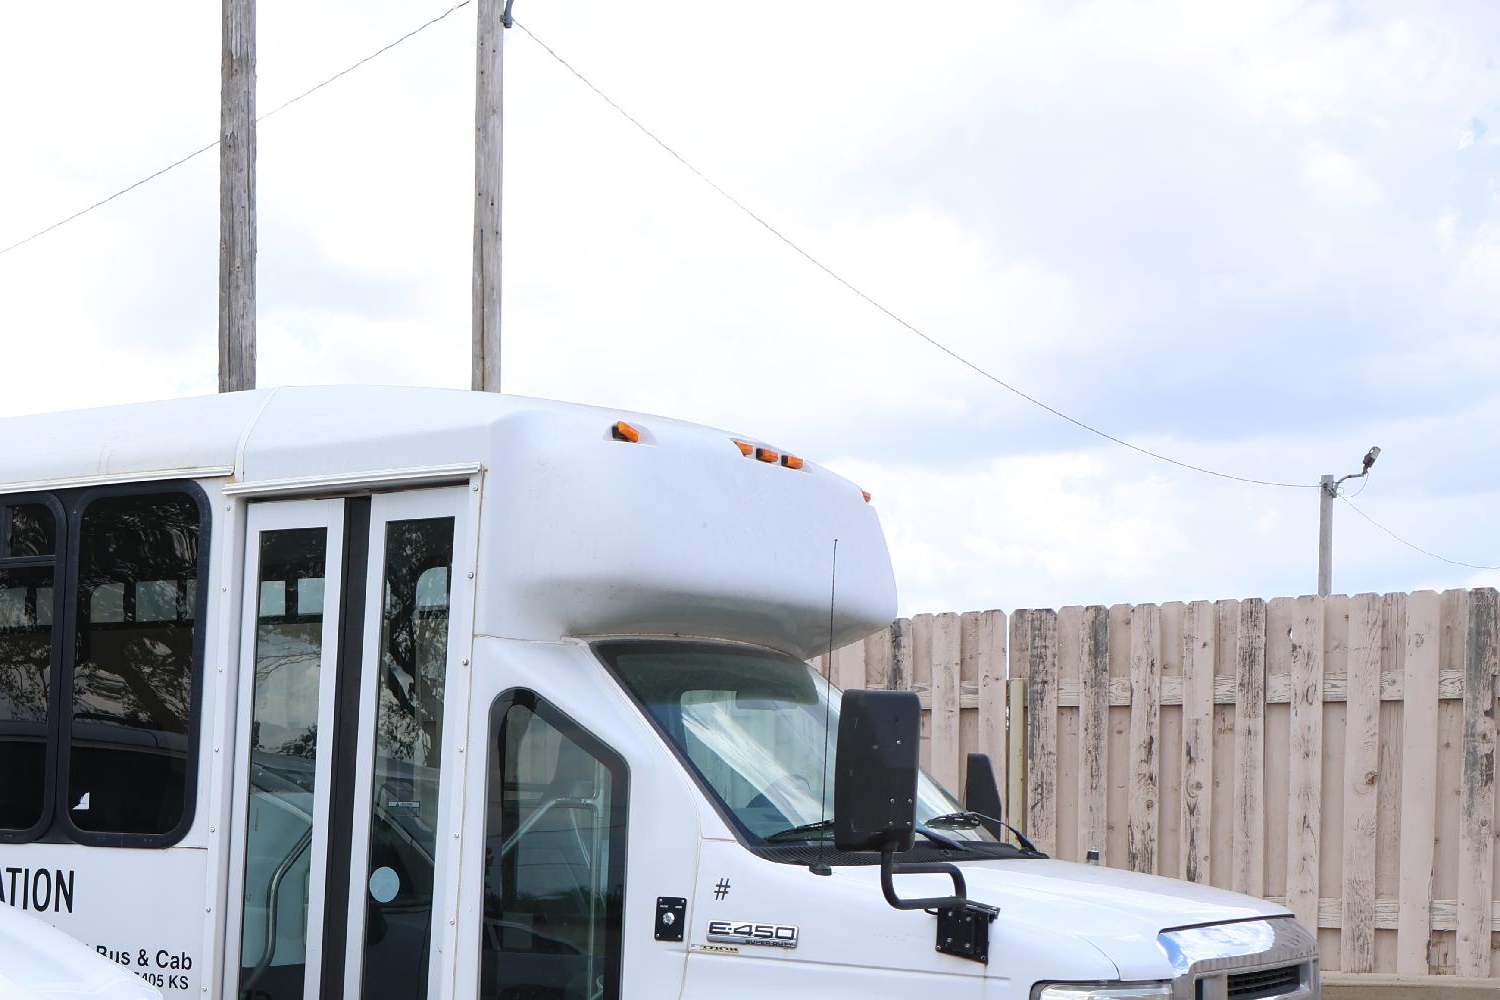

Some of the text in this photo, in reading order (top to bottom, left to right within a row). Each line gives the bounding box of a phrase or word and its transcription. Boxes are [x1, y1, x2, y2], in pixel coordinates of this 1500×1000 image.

[137, 948, 149, 967] &
[155, 950, 192, 970] Cab
[134, 972, 189, 990] 405 KS
